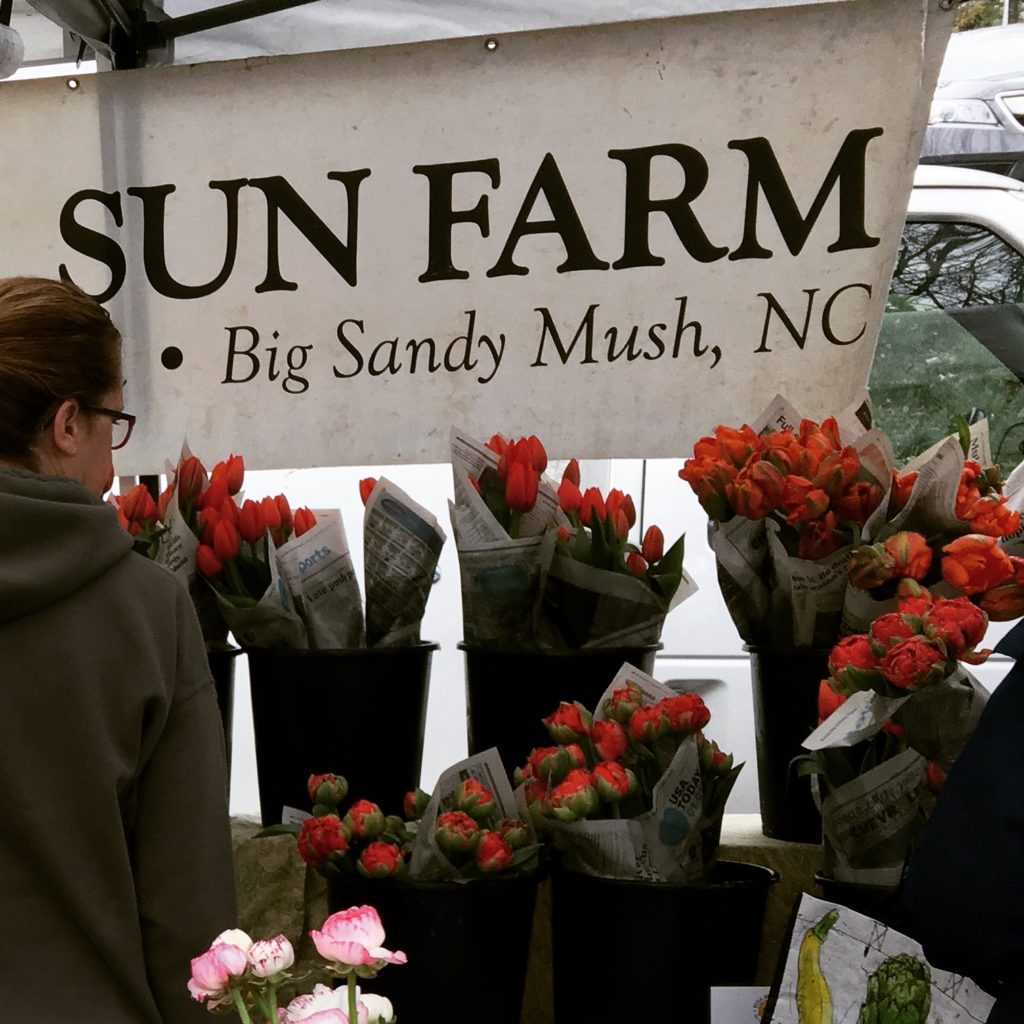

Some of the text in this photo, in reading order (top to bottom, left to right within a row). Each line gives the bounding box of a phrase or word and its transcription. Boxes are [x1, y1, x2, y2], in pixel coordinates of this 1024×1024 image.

[58, 168, 372, 304] SUN
[412, 127, 884, 284] FARM
[220, 325, 314, 395] Big
[332, 309, 506, 389] Sandy
[529, 295, 723, 370] Mush,
[753, 282, 873, 354] NC
[668, 780, 689, 804] USA
[677, 767, 701, 809] TODAY
